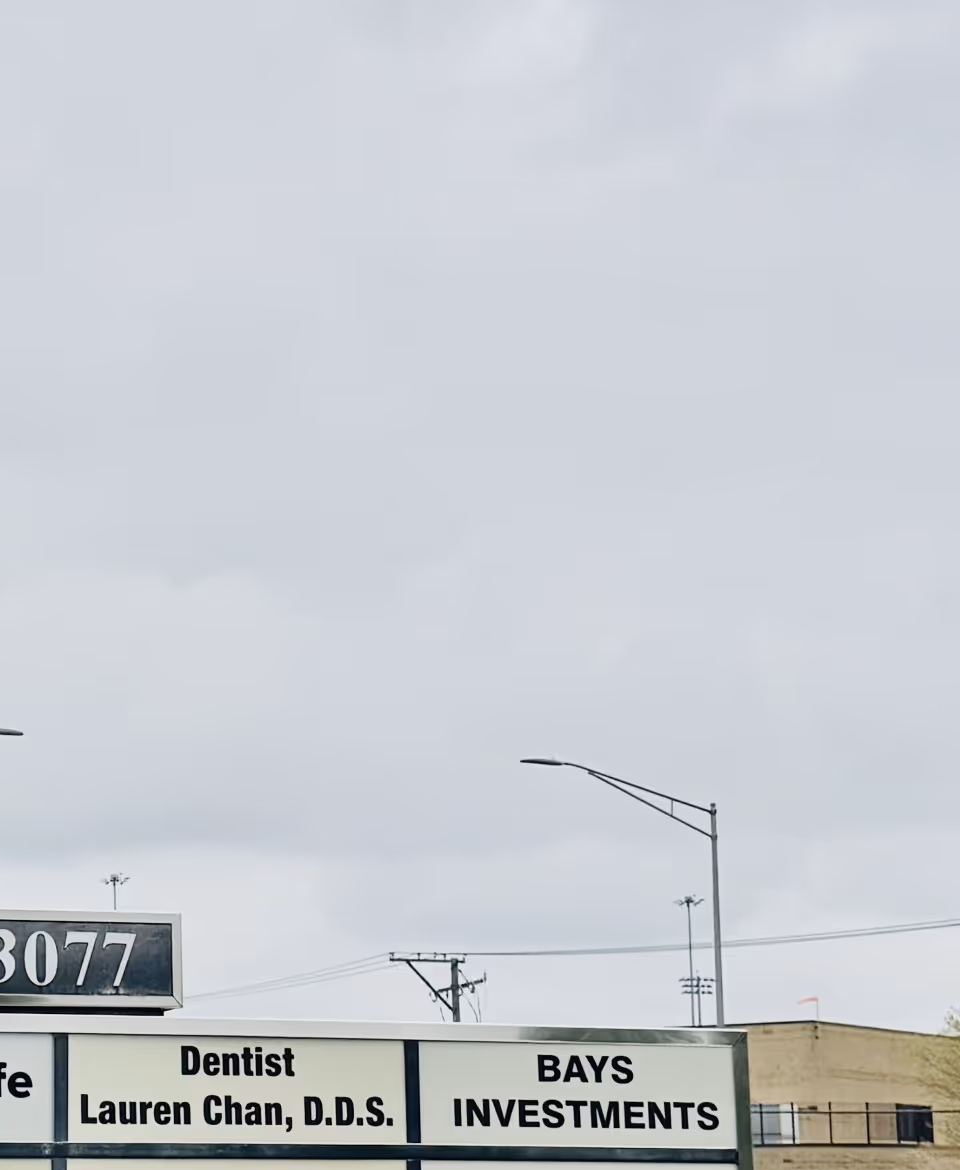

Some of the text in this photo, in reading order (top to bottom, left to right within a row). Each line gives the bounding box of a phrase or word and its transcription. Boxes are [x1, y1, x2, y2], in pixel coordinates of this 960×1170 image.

[181, 1046, 295, 1076] Dentist
[538, 1055, 633, 1084] BAYS
[81, 1094, 393, 1132] Lauren Chan, D.D.S.
[454, 1099, 719, 1130] INVESTMENTS
